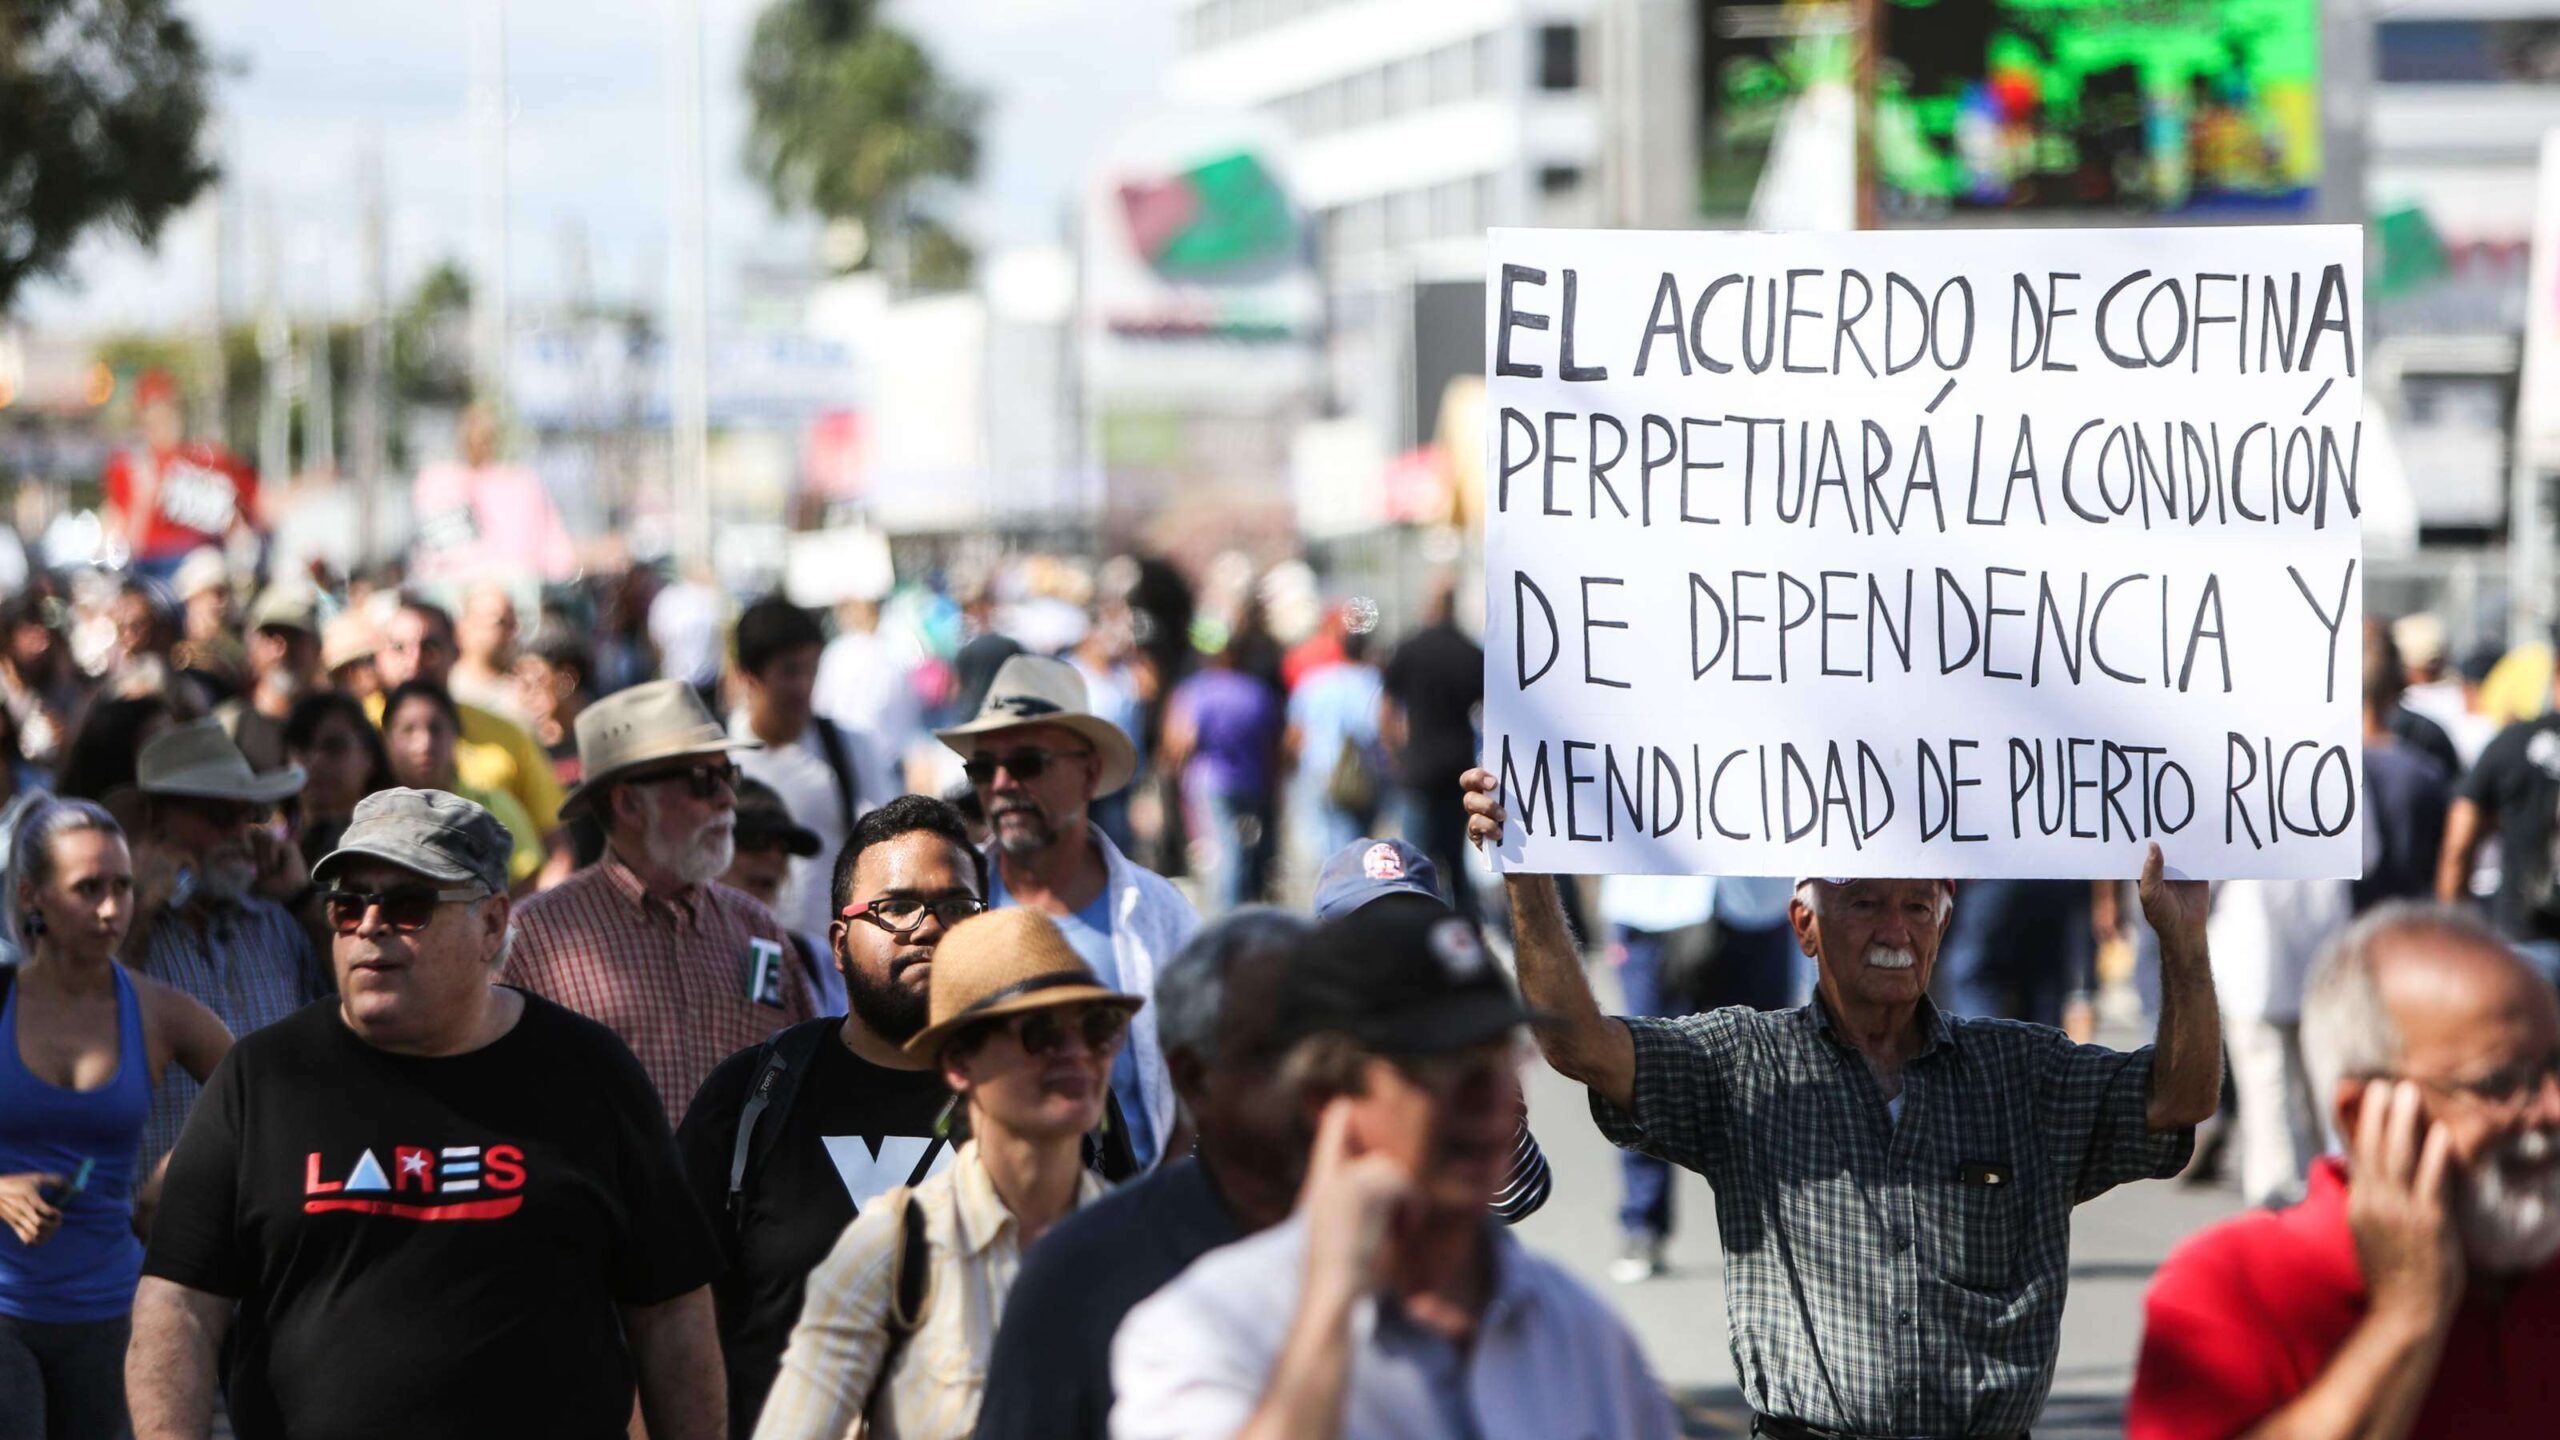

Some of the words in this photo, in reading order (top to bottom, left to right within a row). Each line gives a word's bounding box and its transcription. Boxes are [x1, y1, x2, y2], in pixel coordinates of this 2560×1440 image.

[1495, 263, 1608, 382] EL
[1633, 269, 1975, 379] ACUERDO
[2010, 271, 2081, 373] DE
[2095, 263, 2355, 378] COFINA
[1498, 378, 1957, 536] PERPETUARÁ
[1966, 414, 2046, 526] LA
[2061, 378, 2362, 530] CONDICIÓN
[1514, 570, 1631, 692] DE
[1689, 566, 2232, 693] DEPENDENCIA
[2287, 558, 2356, 703] Y
[1497, 733, 1895, 851] MENDICIDAD
[1917, 737, 1990, 844] DE
[2008, 736, 2196, 844] PUERTO
[2225, 731, 2356, 851] RICO
[306, 1144, 527, 1194] LARES
